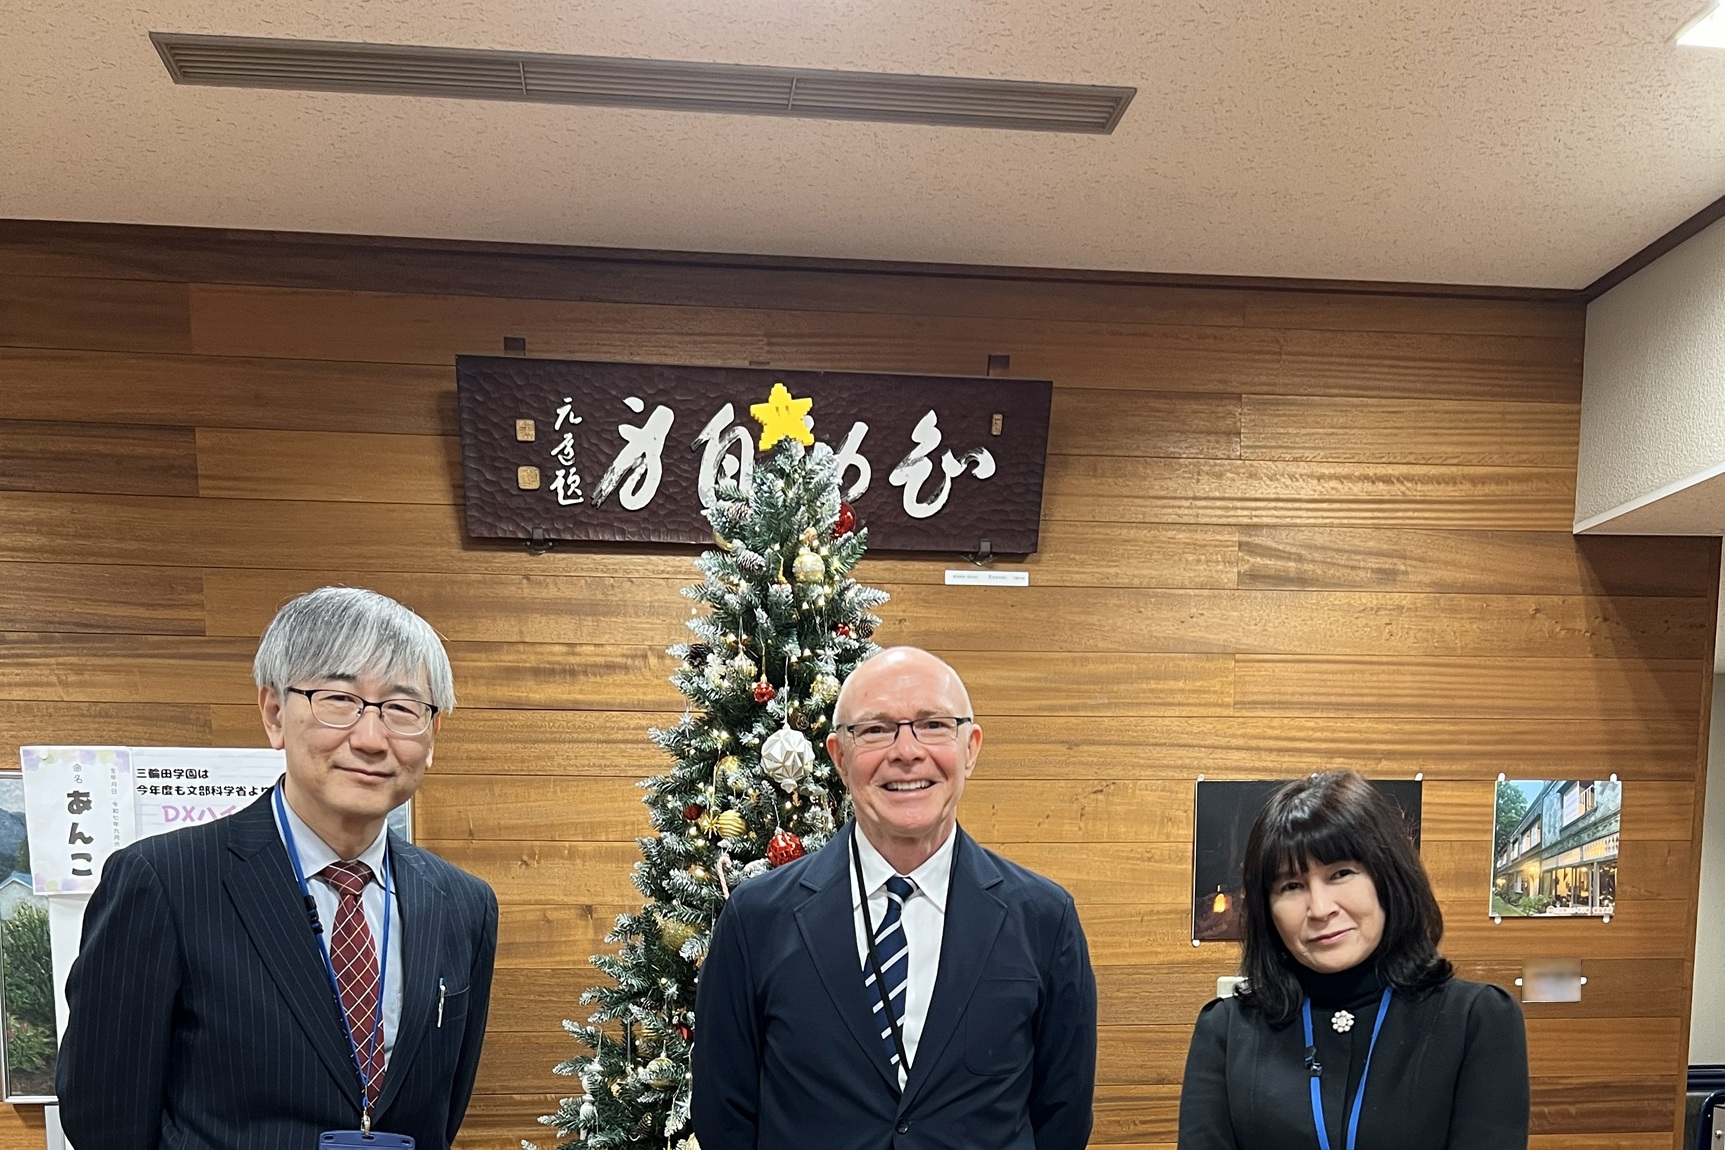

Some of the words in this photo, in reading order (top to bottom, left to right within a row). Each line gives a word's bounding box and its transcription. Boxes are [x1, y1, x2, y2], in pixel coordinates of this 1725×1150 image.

[73, 763, 83, 784] 命名
[136, 768, 210, 780] 三輪田学園は
[67, 790, 95, 877] あんこ
